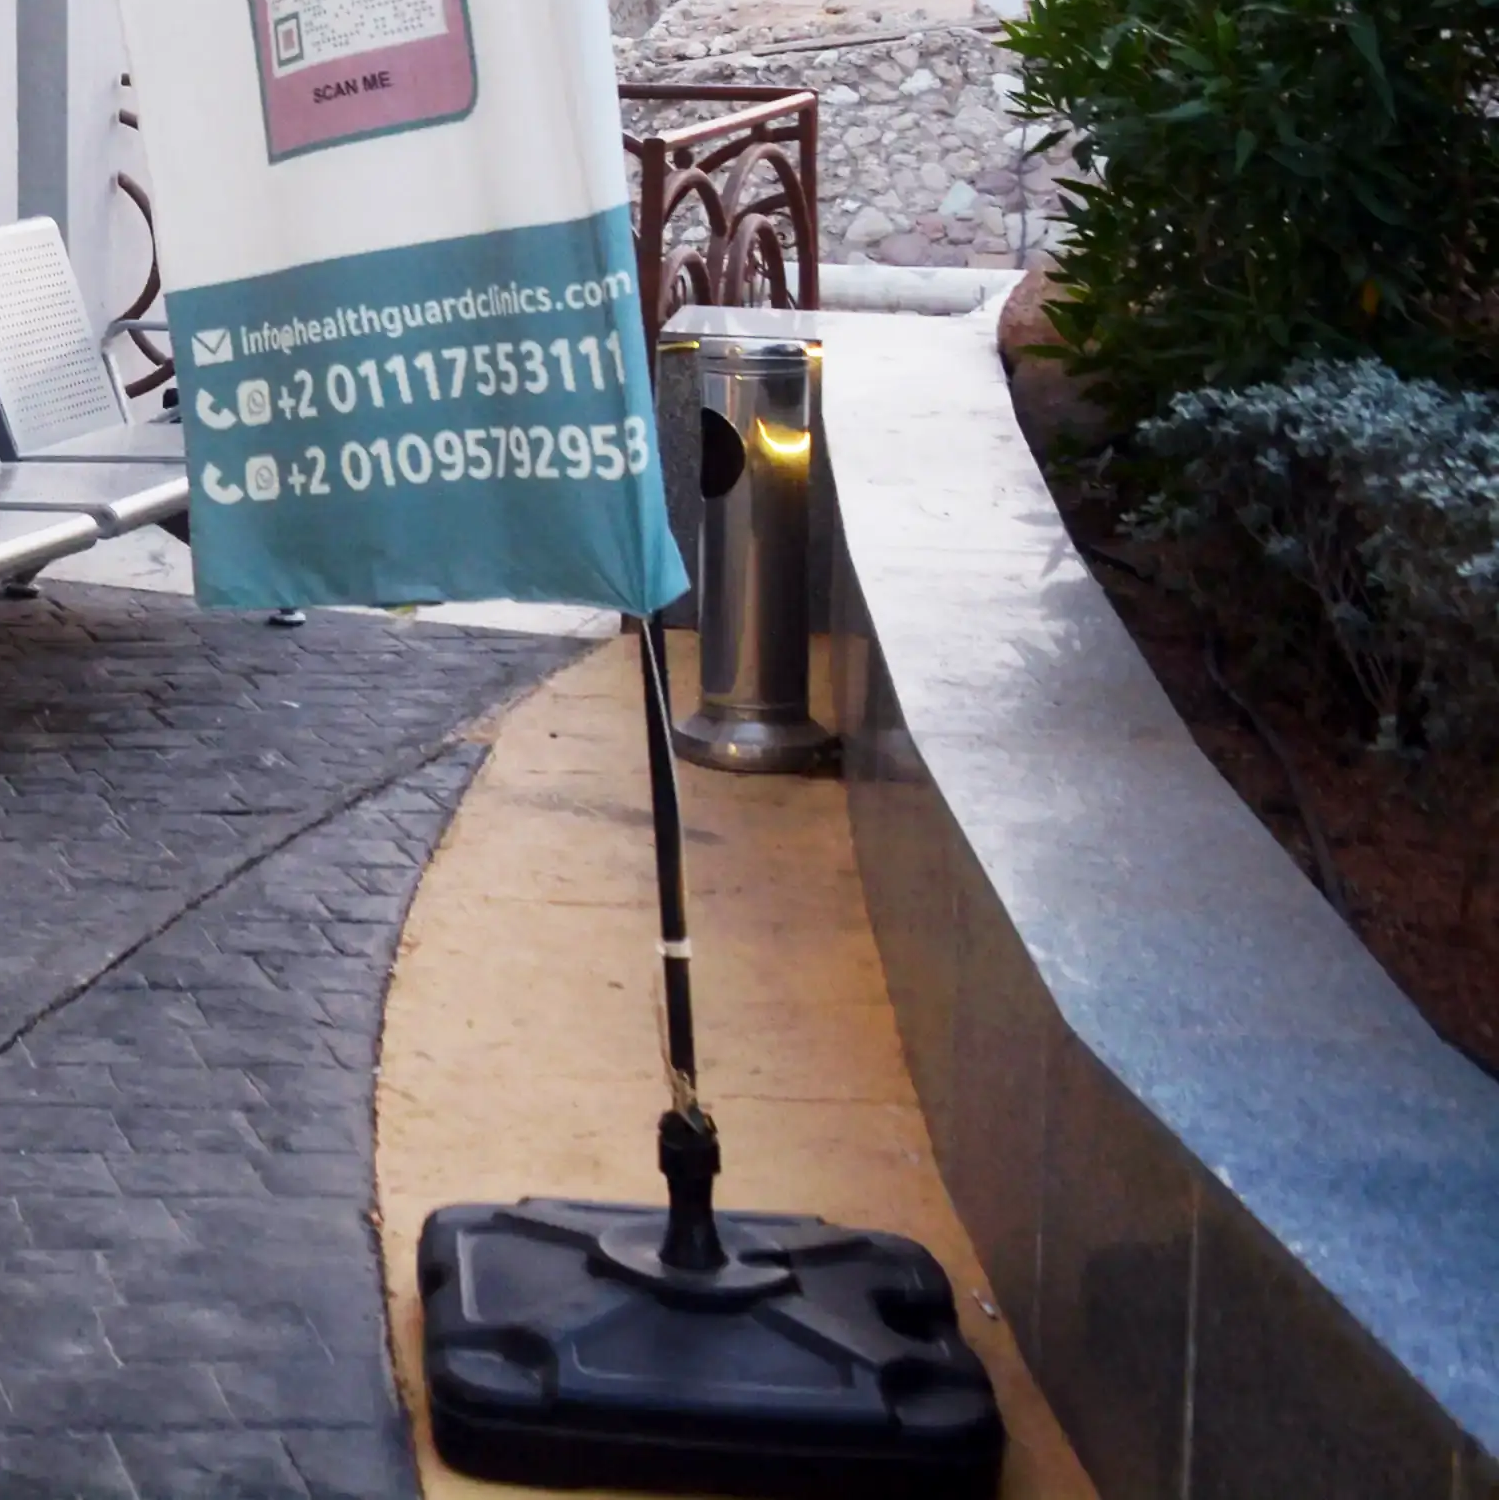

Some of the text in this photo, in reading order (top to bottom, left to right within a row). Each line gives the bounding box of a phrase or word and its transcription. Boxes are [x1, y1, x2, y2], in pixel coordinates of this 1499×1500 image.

[312, 70, 393, 105] SCAN ME
[277, 330, 624, 421] +2 01117553111
[288, 415, 649, 497] +2 01095792958
